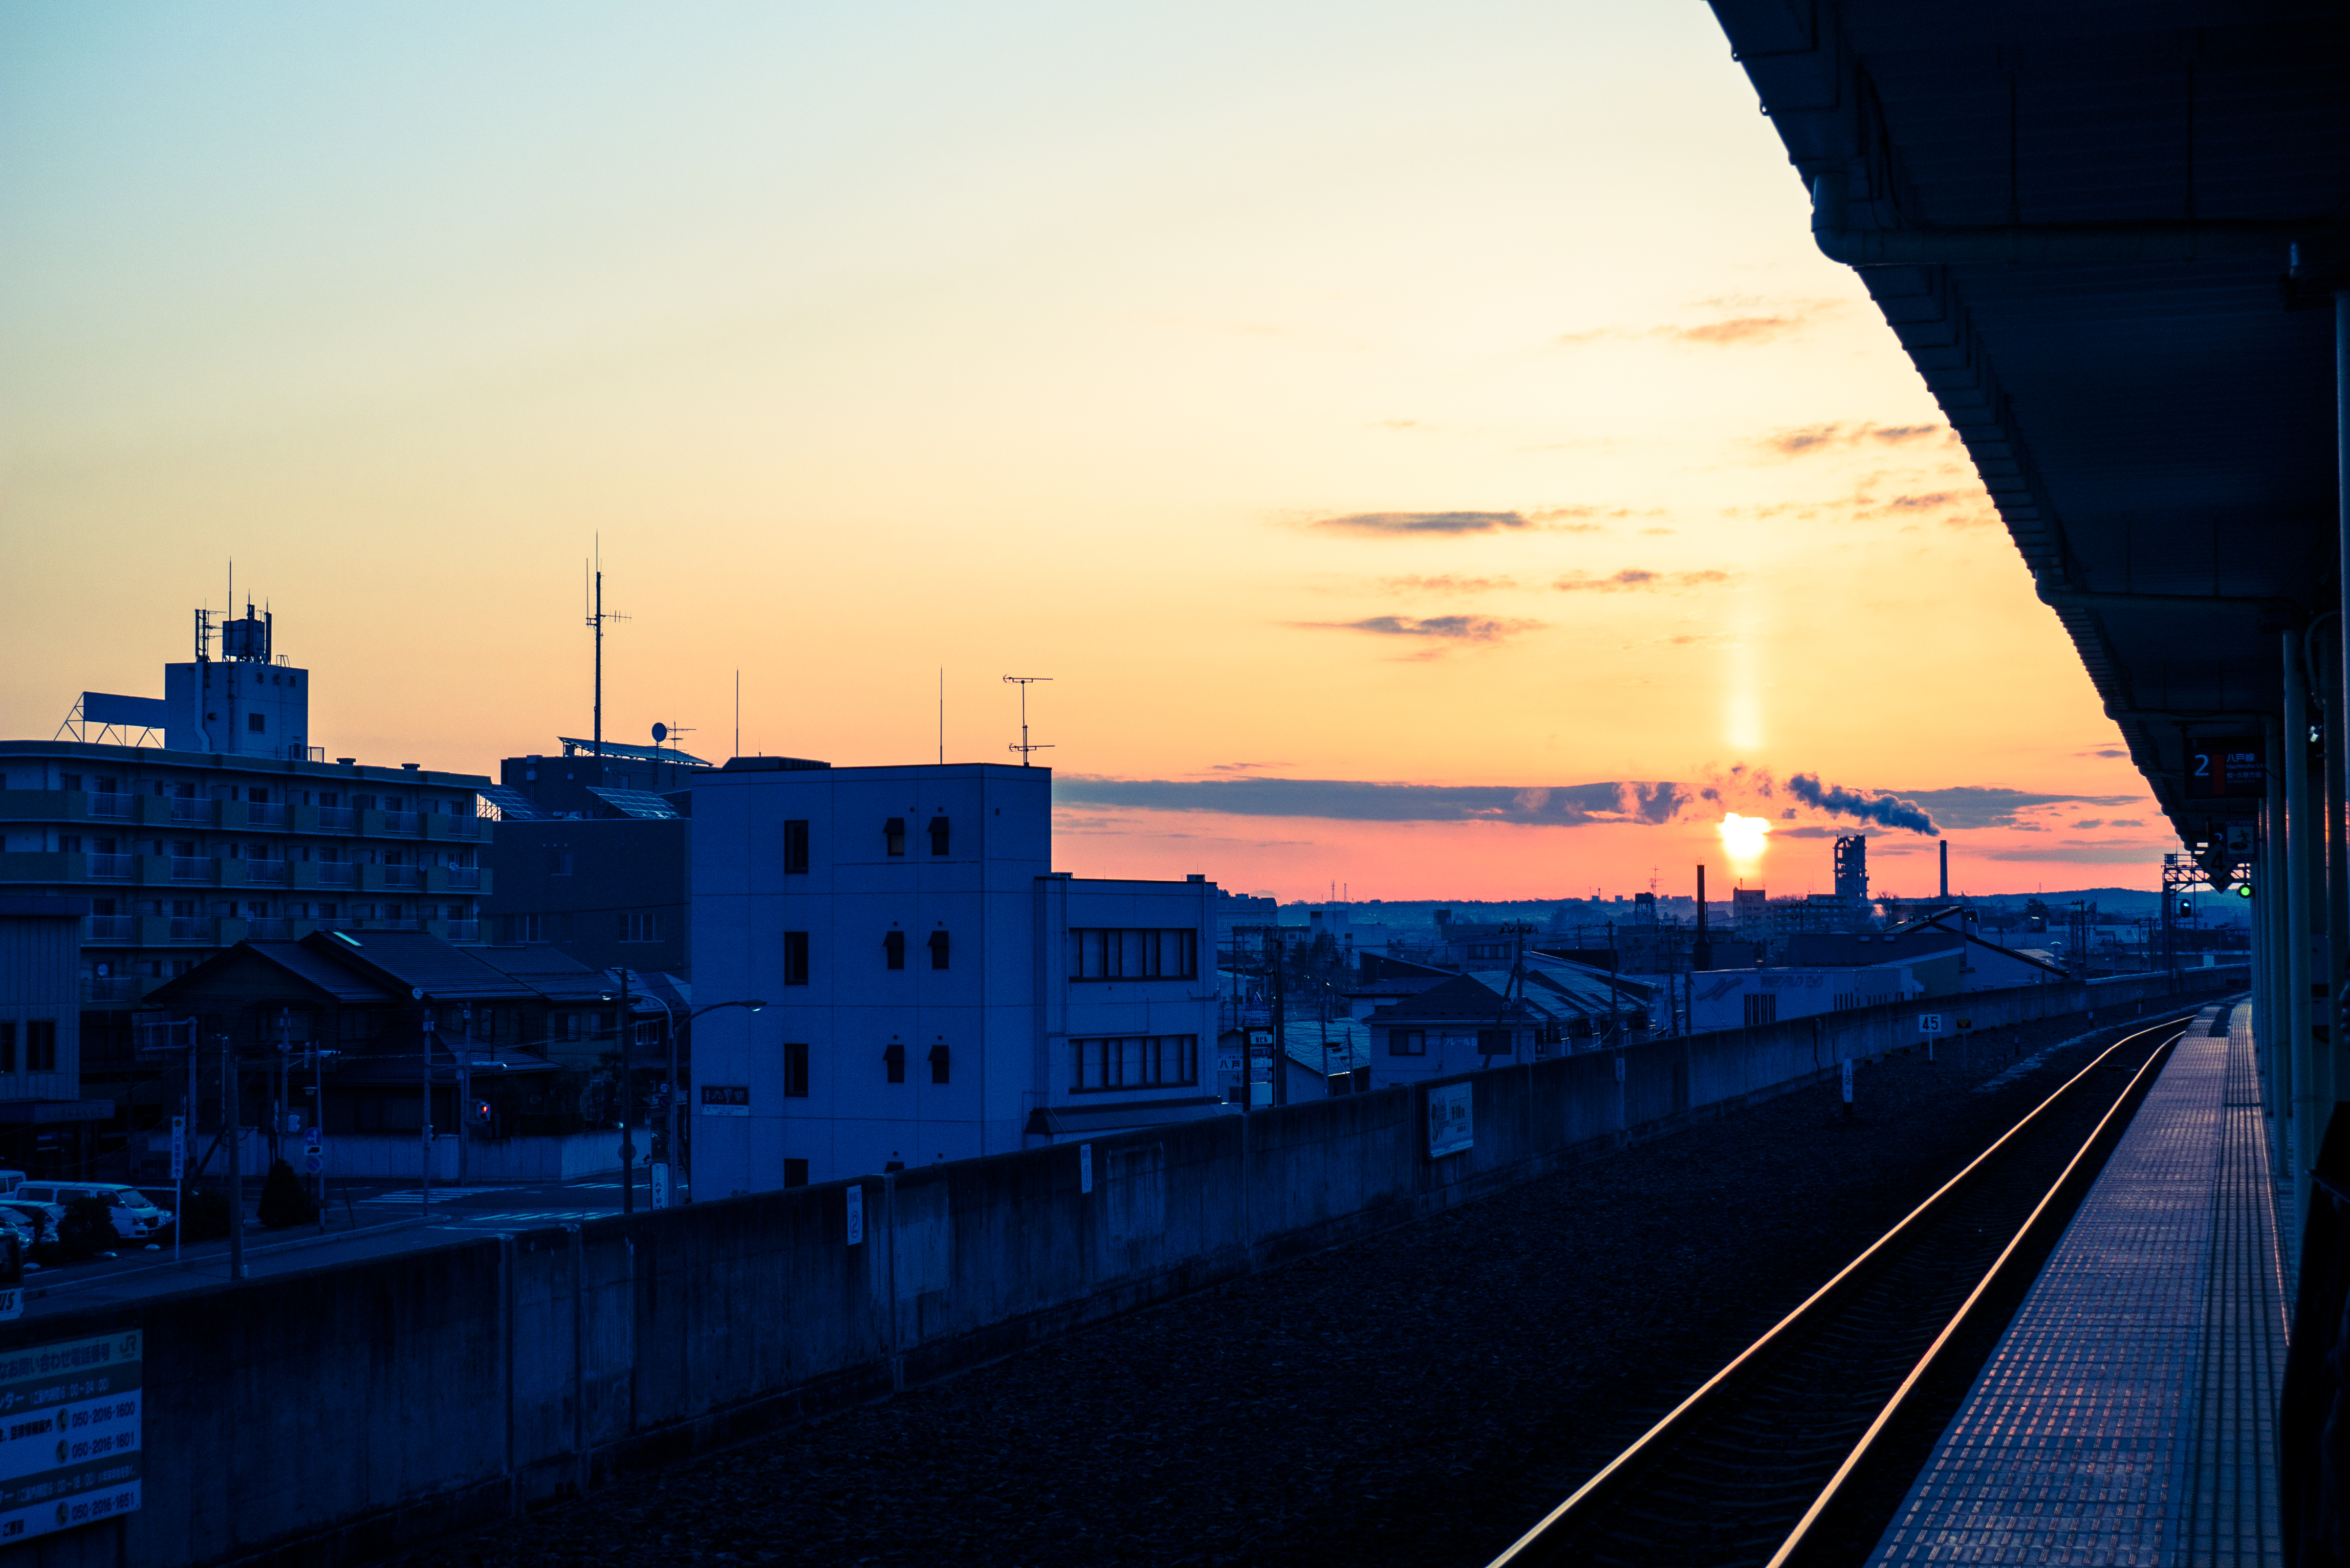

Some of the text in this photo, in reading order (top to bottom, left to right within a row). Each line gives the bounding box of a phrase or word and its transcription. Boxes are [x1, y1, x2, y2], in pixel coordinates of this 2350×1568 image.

[2194, 754, 2209, 776] 2
[2226, 753, 2255, 763] 八戸線
[2211, 851, 2226, 872] 4
[1923, 1016, 1938, 1030] 45
[120, 1335, 137, 1354] JR
